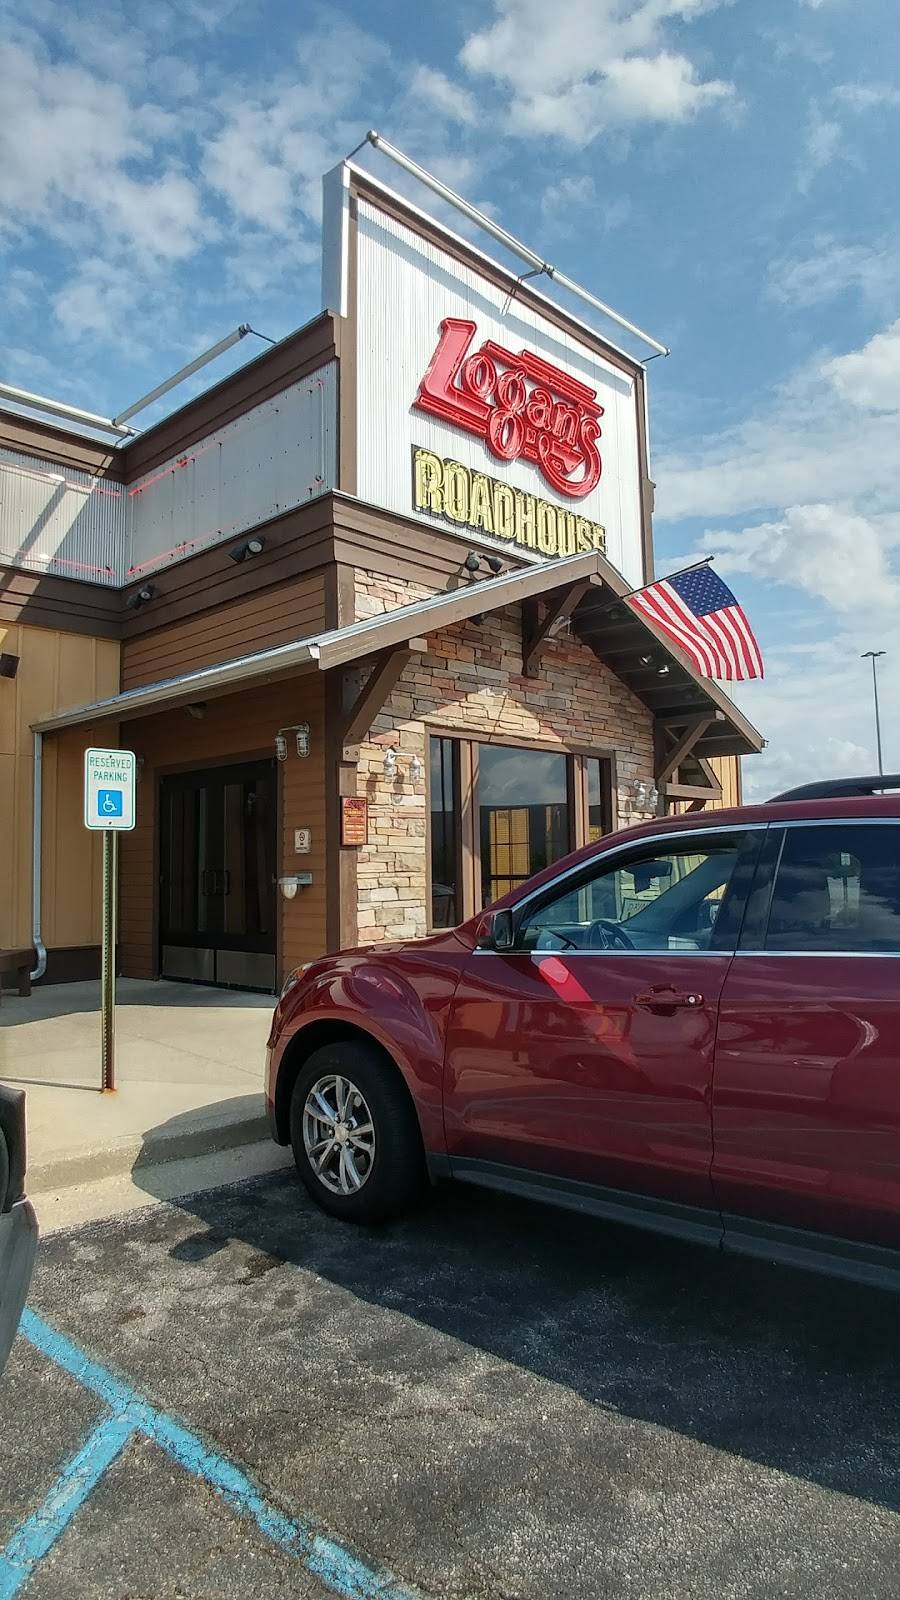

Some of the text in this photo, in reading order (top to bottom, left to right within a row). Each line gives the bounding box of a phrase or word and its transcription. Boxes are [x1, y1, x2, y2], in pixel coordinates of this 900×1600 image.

[411, 318, 603, 497] Logan's
[413, 449, 606, 557] ROADHOUSE
[89, 756, 131, 769] RESERVED
[93, 770, 128, 782] PARKING
